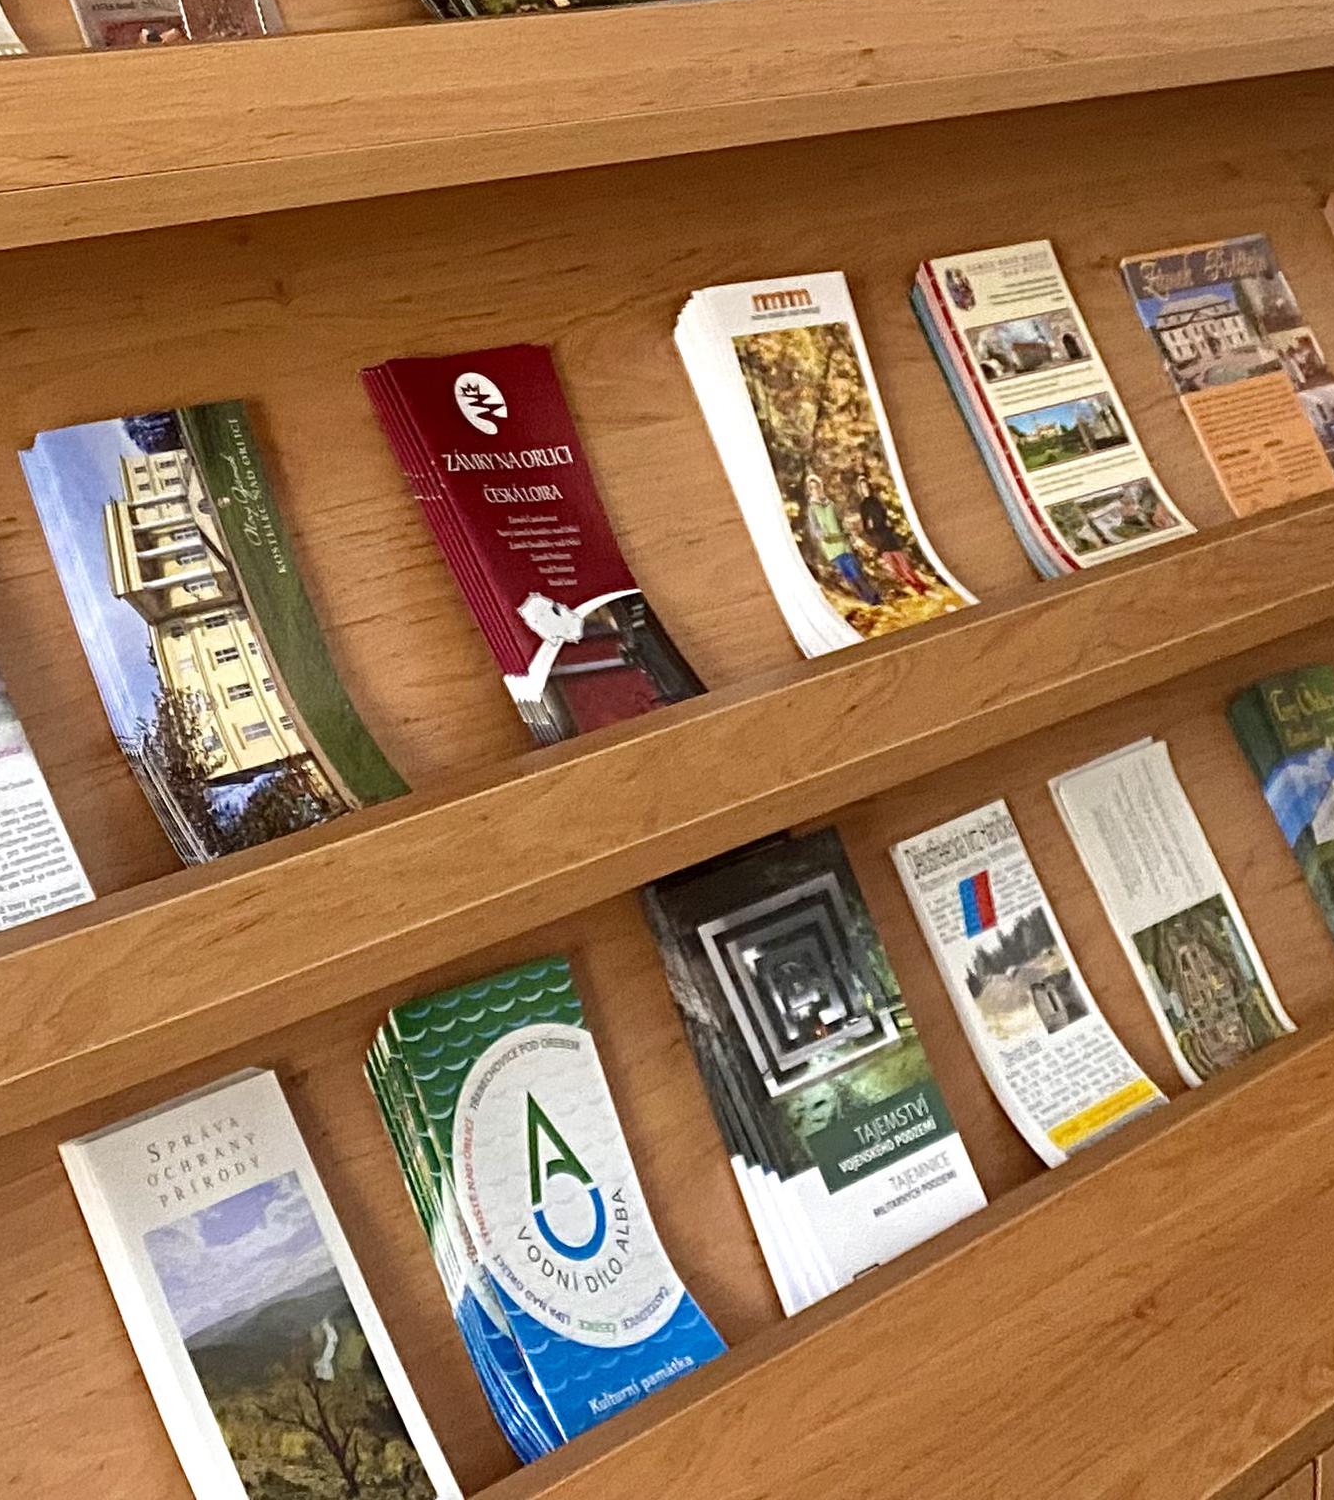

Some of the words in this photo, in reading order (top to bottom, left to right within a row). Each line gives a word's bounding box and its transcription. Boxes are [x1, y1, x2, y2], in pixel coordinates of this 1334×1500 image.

[441, 448, 495, 471] ZÁMKY
[854, 1092, 930, 1145] TAJEMSTVÍ
[517, 1225, 579, 1292] VODNÍ
[585, 1257, 624, 1294] DÍLO
[611, 1187, 631, 1253] ALBA
[588, 1377, 641, 1415] Kulturní
[640, 1356, 695, 1392] památka
